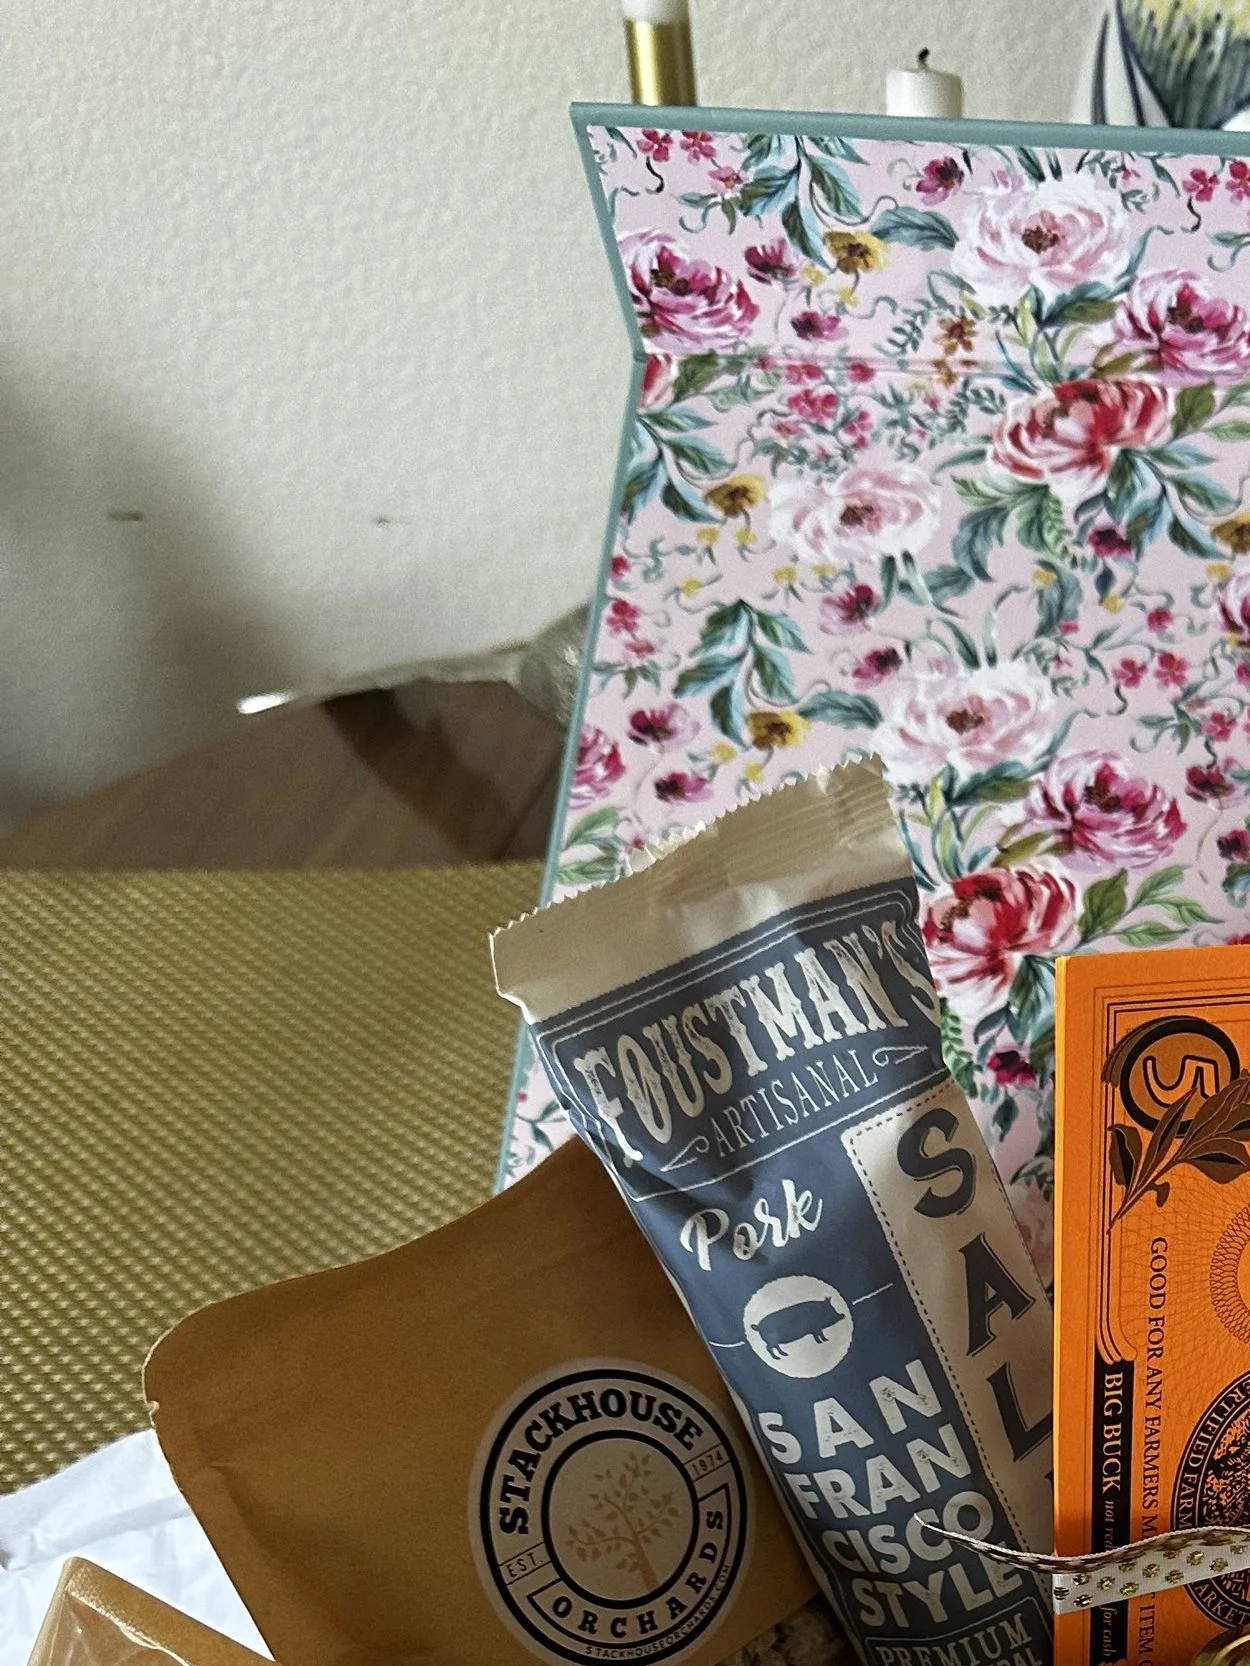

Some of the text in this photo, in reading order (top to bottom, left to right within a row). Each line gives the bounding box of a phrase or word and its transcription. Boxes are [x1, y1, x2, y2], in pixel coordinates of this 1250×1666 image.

[574, 920, 942, 1164] FOUSTMAN'S
[712, 1048, 879, 1157] ARTISANAL
[680, 1178, 824, 1272] Pork
[1147, 1236, 1168, 1308] GOOD
[1146, 1312, 1166, 1362] FOR
[757, 1358, 943, 1465] SAN
[1103, 1371, 1124, 1421] BIG
[1144, 1365, 1163, 1409] ANY
[499, 1387, 704, 1535] STACKHOUSE
[691, 1450, 724, 1474] 1974
[783, 1423, 972, 1520] FRAN
[1100, 1424, 1122, 1495] BUCK
[1141, 1415, 1161, 1512] FARMERS
[821, 1490, 994, 1576] CISCO
[1104, 1499, 1119, 1525] not
[1177, 1471, 1199, 1531] FARM
[506, 1551, 543, 1579] EST.
[552, 1510, 723, 1639] ORCHARDS
[845, 1542, 1024, 1628] STYLE
[1098, 1606, 1117, 1657] for cash
[1137, 1604, 1155, 1656] ITEM
